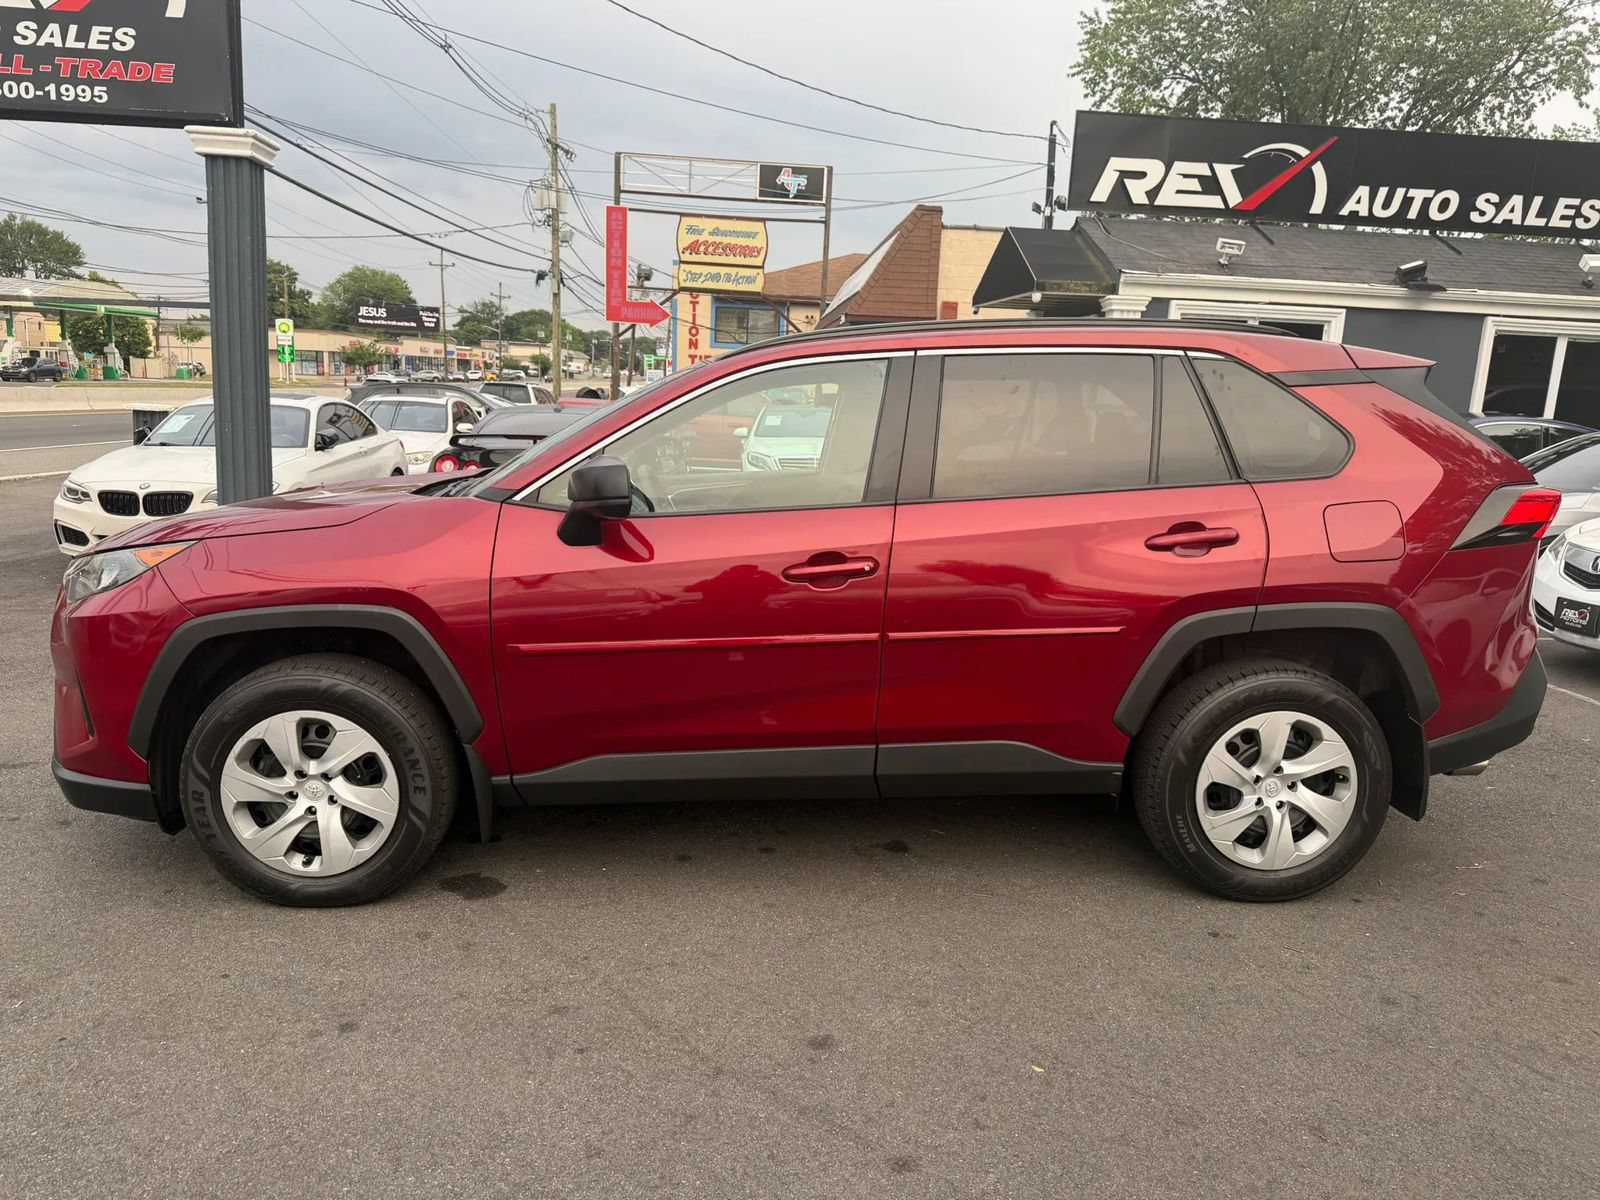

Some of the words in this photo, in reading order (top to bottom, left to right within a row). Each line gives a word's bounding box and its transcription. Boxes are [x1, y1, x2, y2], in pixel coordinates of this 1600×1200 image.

[13, 21, 136, 51] SALES
[55, 57, 175, 83] TRADE
[0, 80, 109, 103] 00-1995
[1089, 144, 1312, 211] REV
[1338, 185, 1460, 221] AUTO
[1469, 192, 1600, 229] SALES
[681, 239, 764, 258] ACCESSORIES
[357, 306, 387, 317] JESUS
